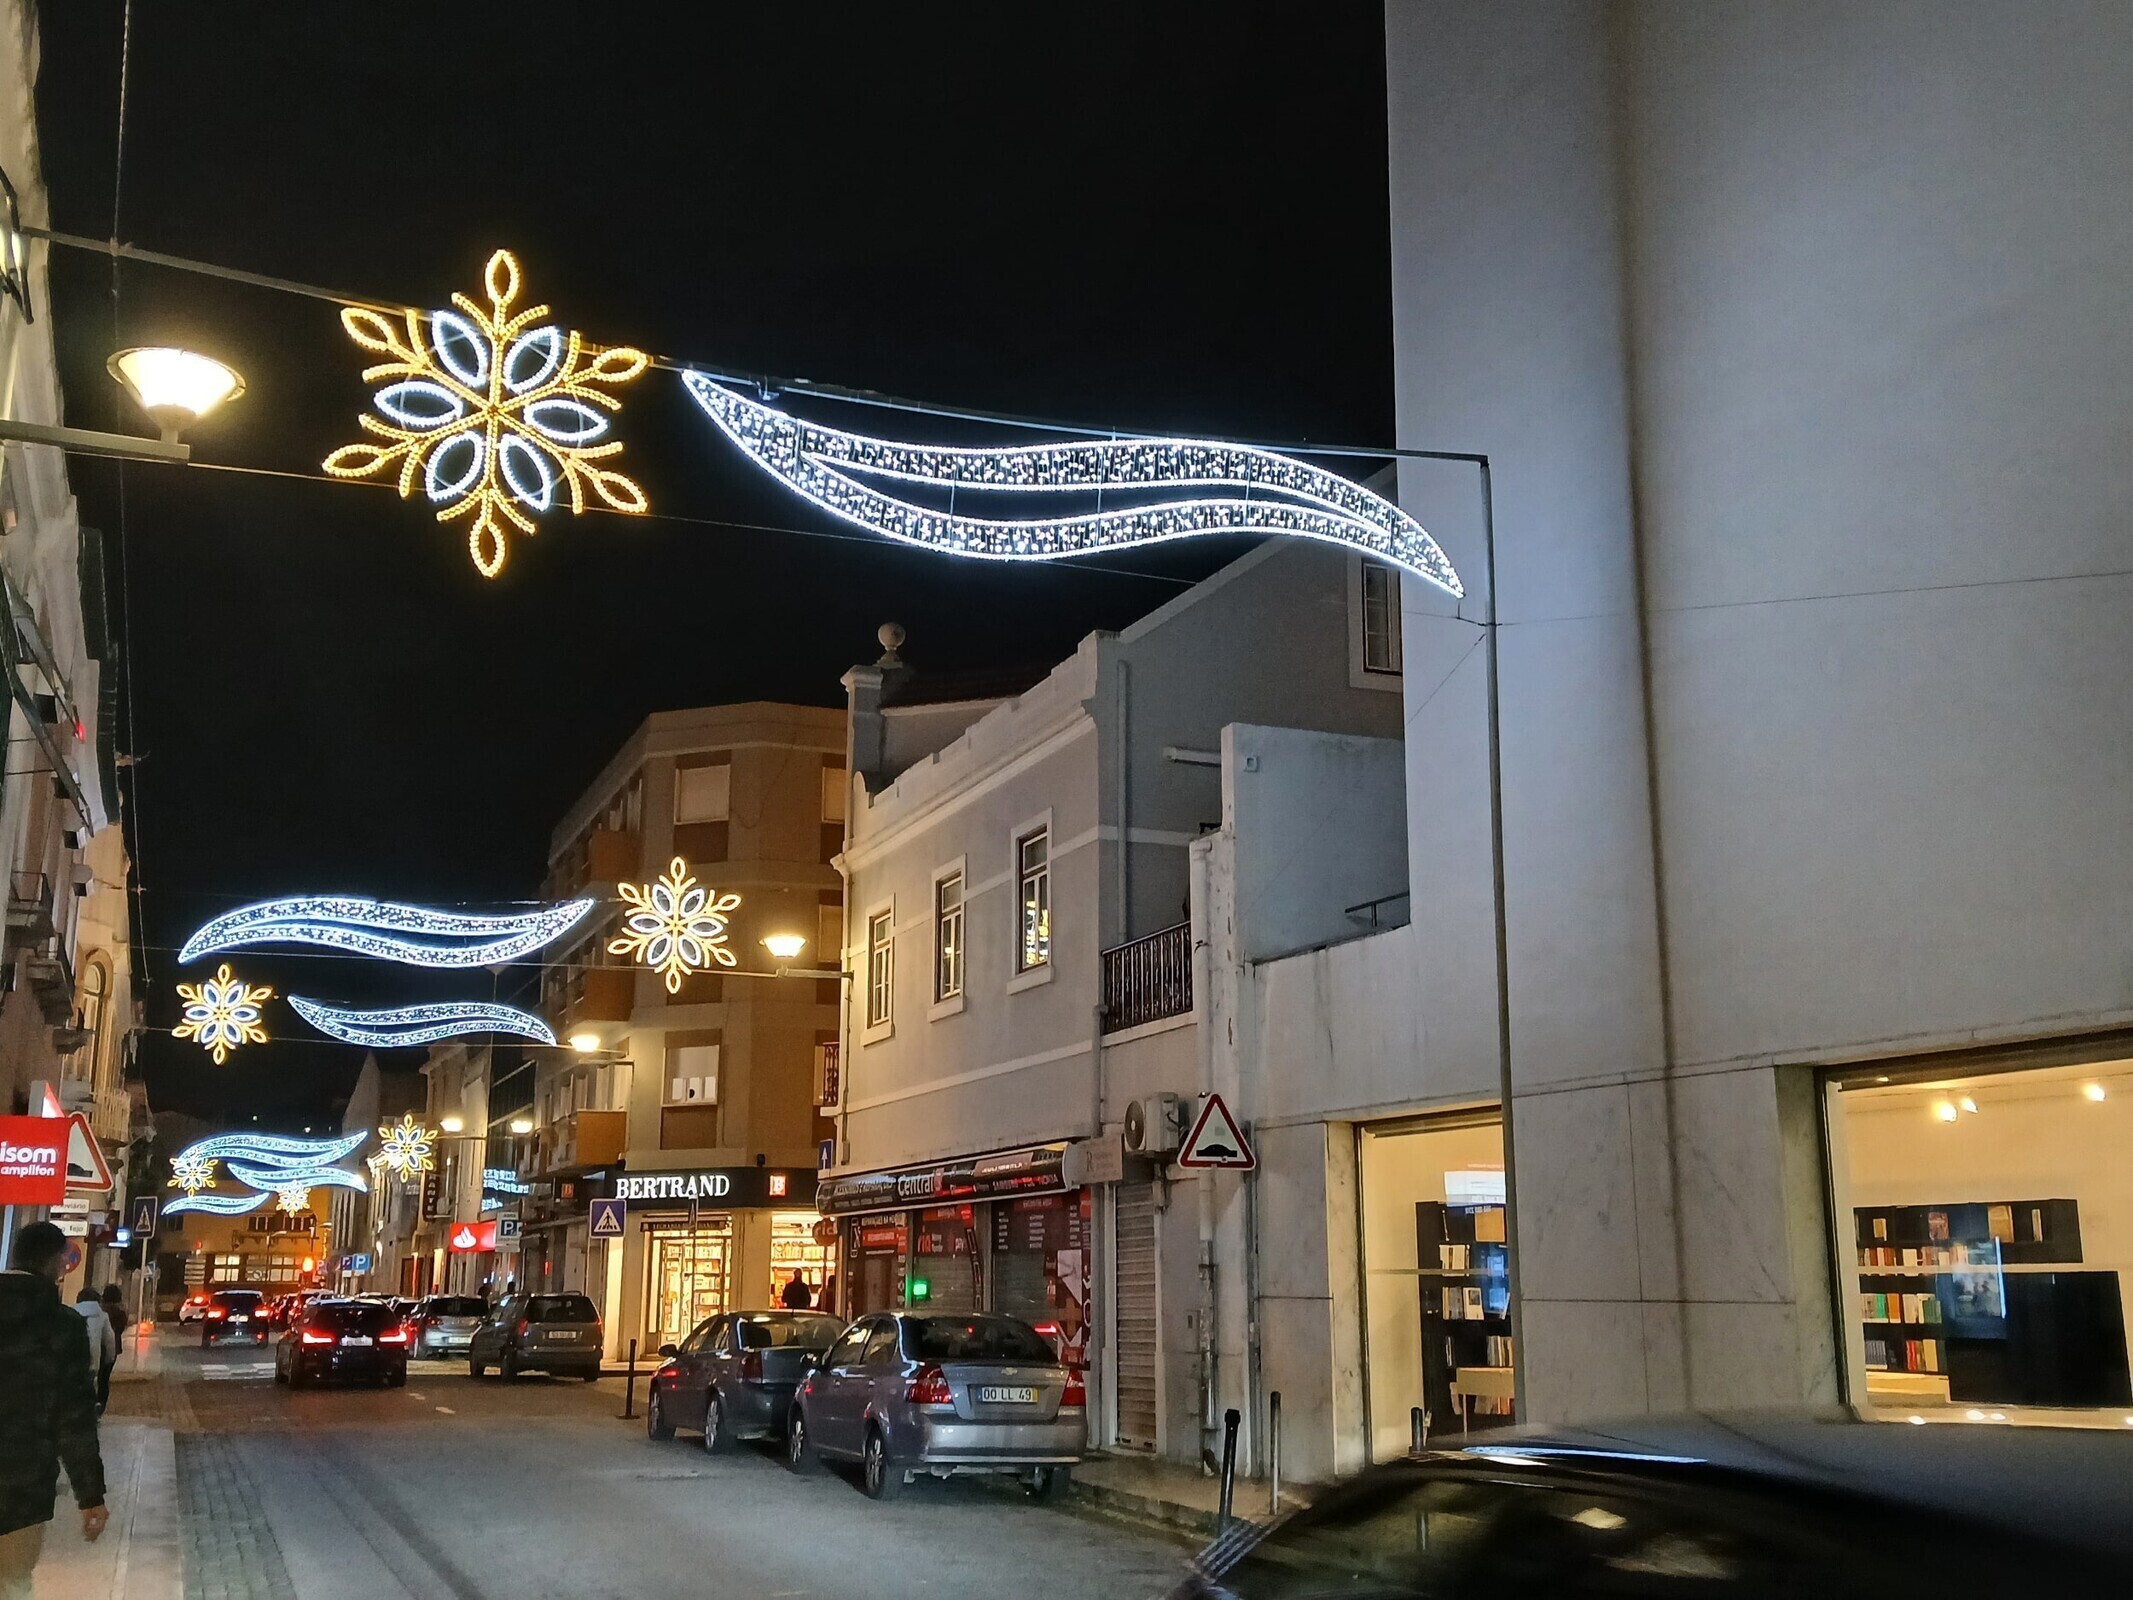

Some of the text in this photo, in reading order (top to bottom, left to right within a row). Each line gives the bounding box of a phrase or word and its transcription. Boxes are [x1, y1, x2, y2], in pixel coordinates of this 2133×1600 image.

[0, 1164, 55, 1178] amplifon
[616, 1175, 730, 1198] BERTRAND
[897, 1169, 934, 1197] Central
[1001, 1388, 1015, 1400] LL
[1019, 1388, 1032, 1400] 49
